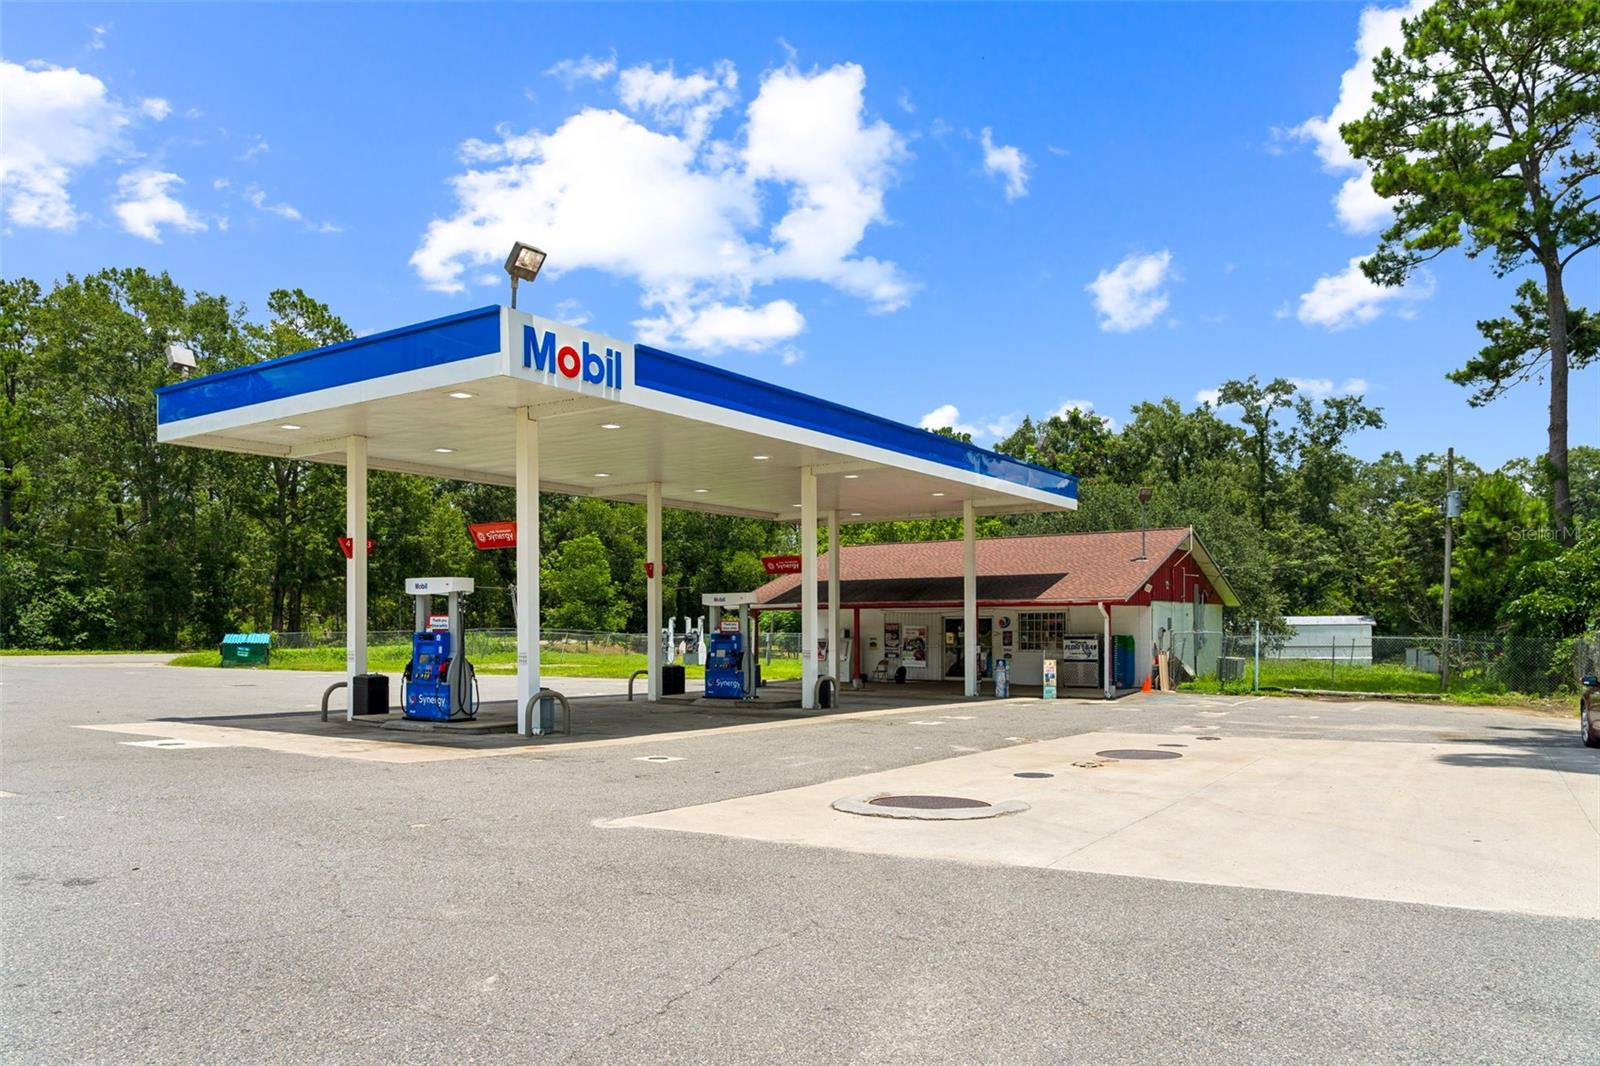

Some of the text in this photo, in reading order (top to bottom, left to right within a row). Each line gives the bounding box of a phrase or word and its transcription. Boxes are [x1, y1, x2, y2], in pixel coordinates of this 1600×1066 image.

[523, 324, 622, 390] Mobil
[486, 531, 513, 542] Synergy
[716, 679, 741, 689] Synergy
[418, 694, 446, 708] Synergy
